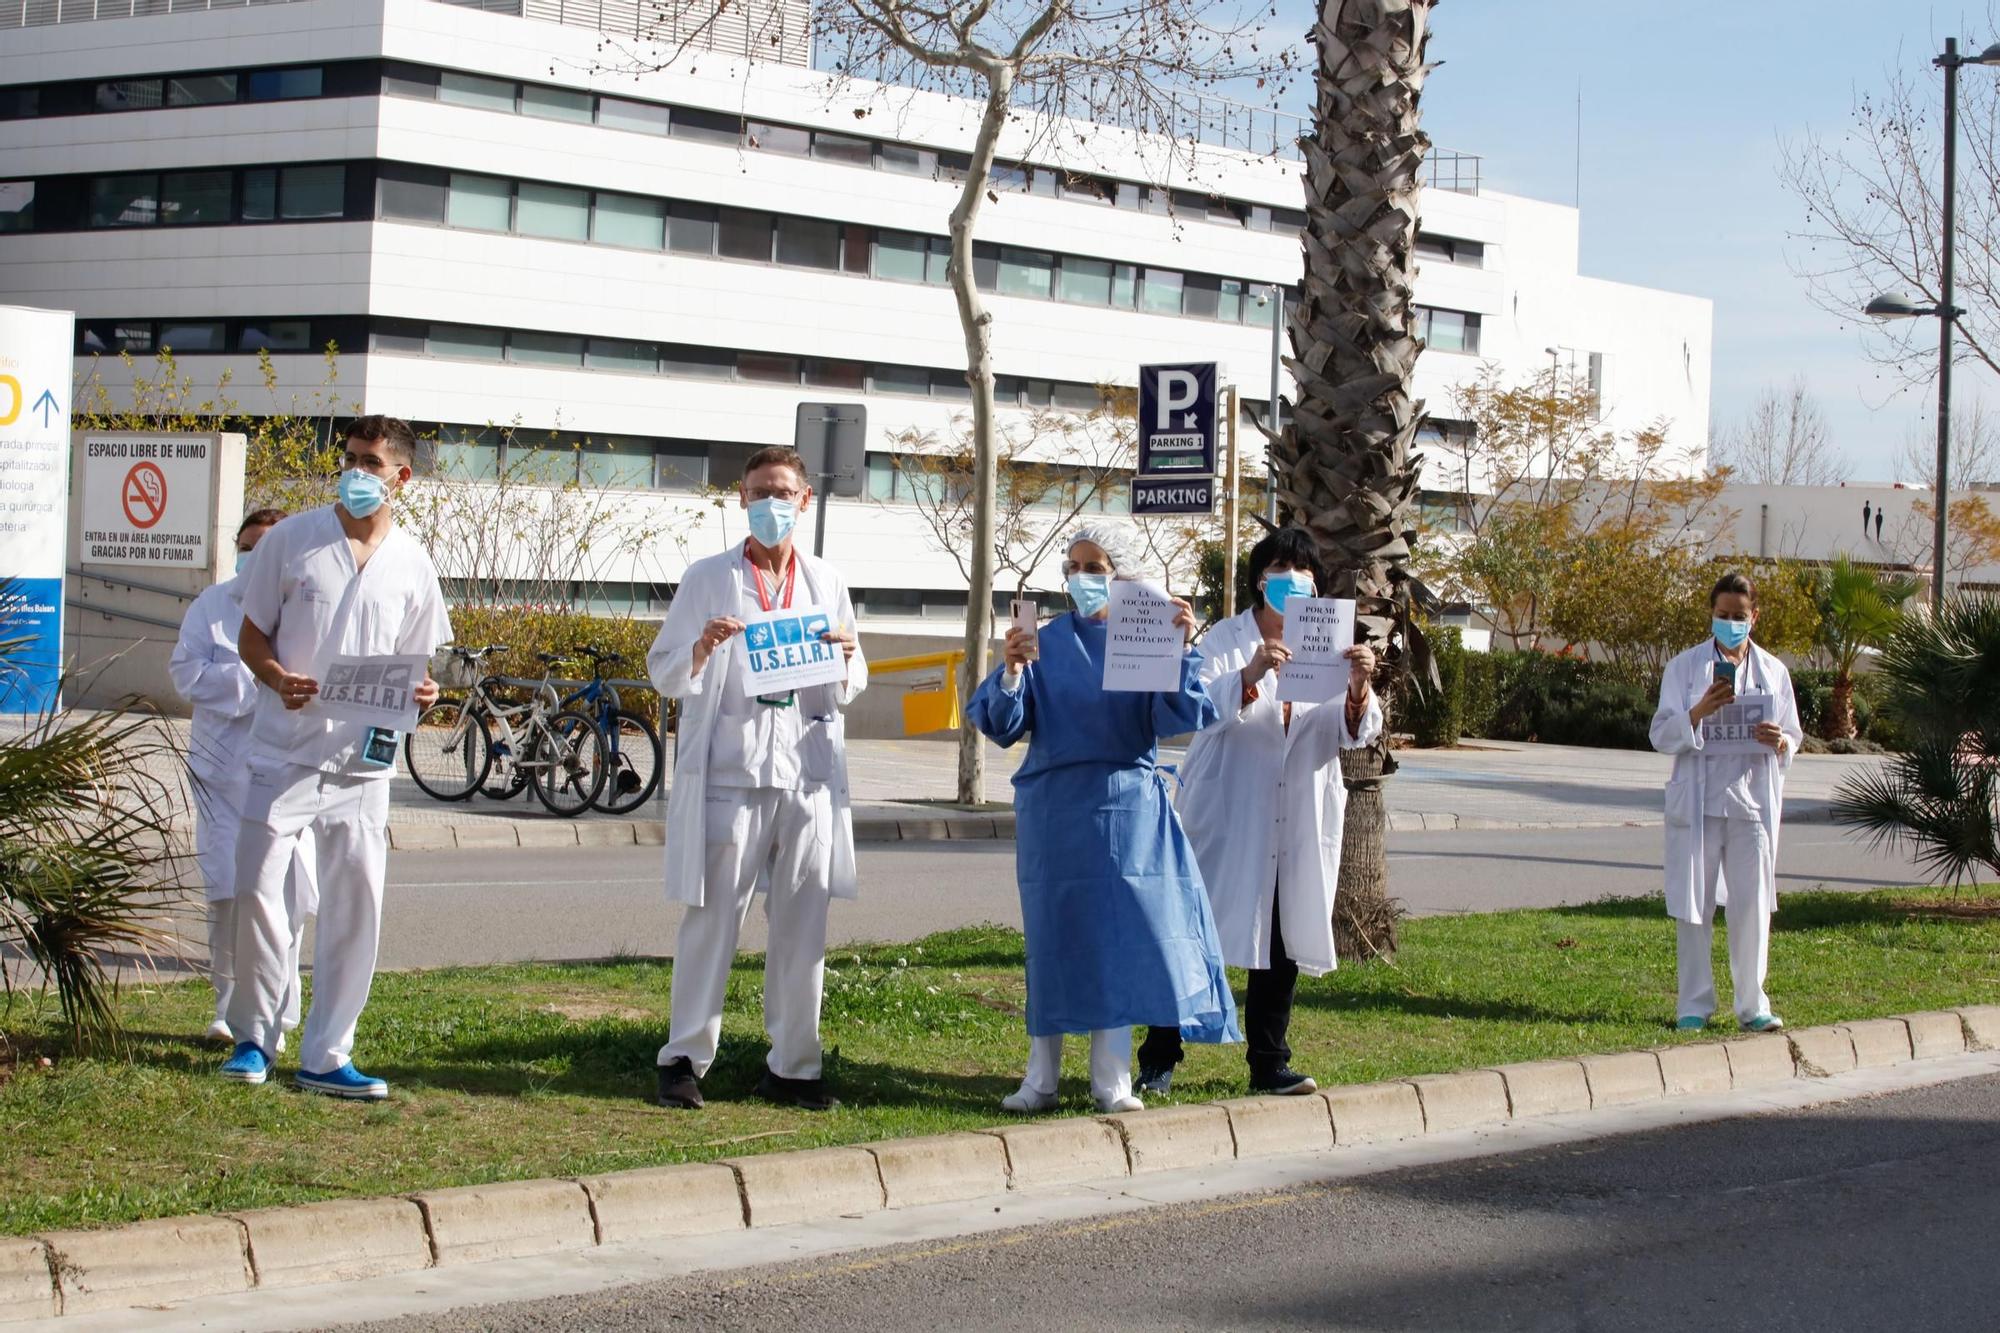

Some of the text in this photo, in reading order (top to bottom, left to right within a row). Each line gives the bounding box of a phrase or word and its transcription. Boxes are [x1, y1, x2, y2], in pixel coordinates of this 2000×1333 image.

[1157, 370, 1199, 430] P
[1151, 437, 1203, 448] PARKING 1
[88, 443, 206, 459] ESPACIO LIBRE DE HUMO
[1136, 488, 1207, 505] PARKING
[85, 531, 202, 545] ENTRA EN UN ÁREA HOSPITALARIA
[91, 545, 193, 561] GRACIAS POR NO FUMAR
[1305, 606, 1336, 615] POR MI
[1299, 615, 1340, 624] DERECHO
[1136, 626, 1148, 634] LA
[1303, 635, 1320, 643] POR
[1301, 644, 1329, 653] SALUD
[749, 641, 835, 673] U.S.E.I.R.I
[320, 685, 408, 712] U.S.E.I.R.I
